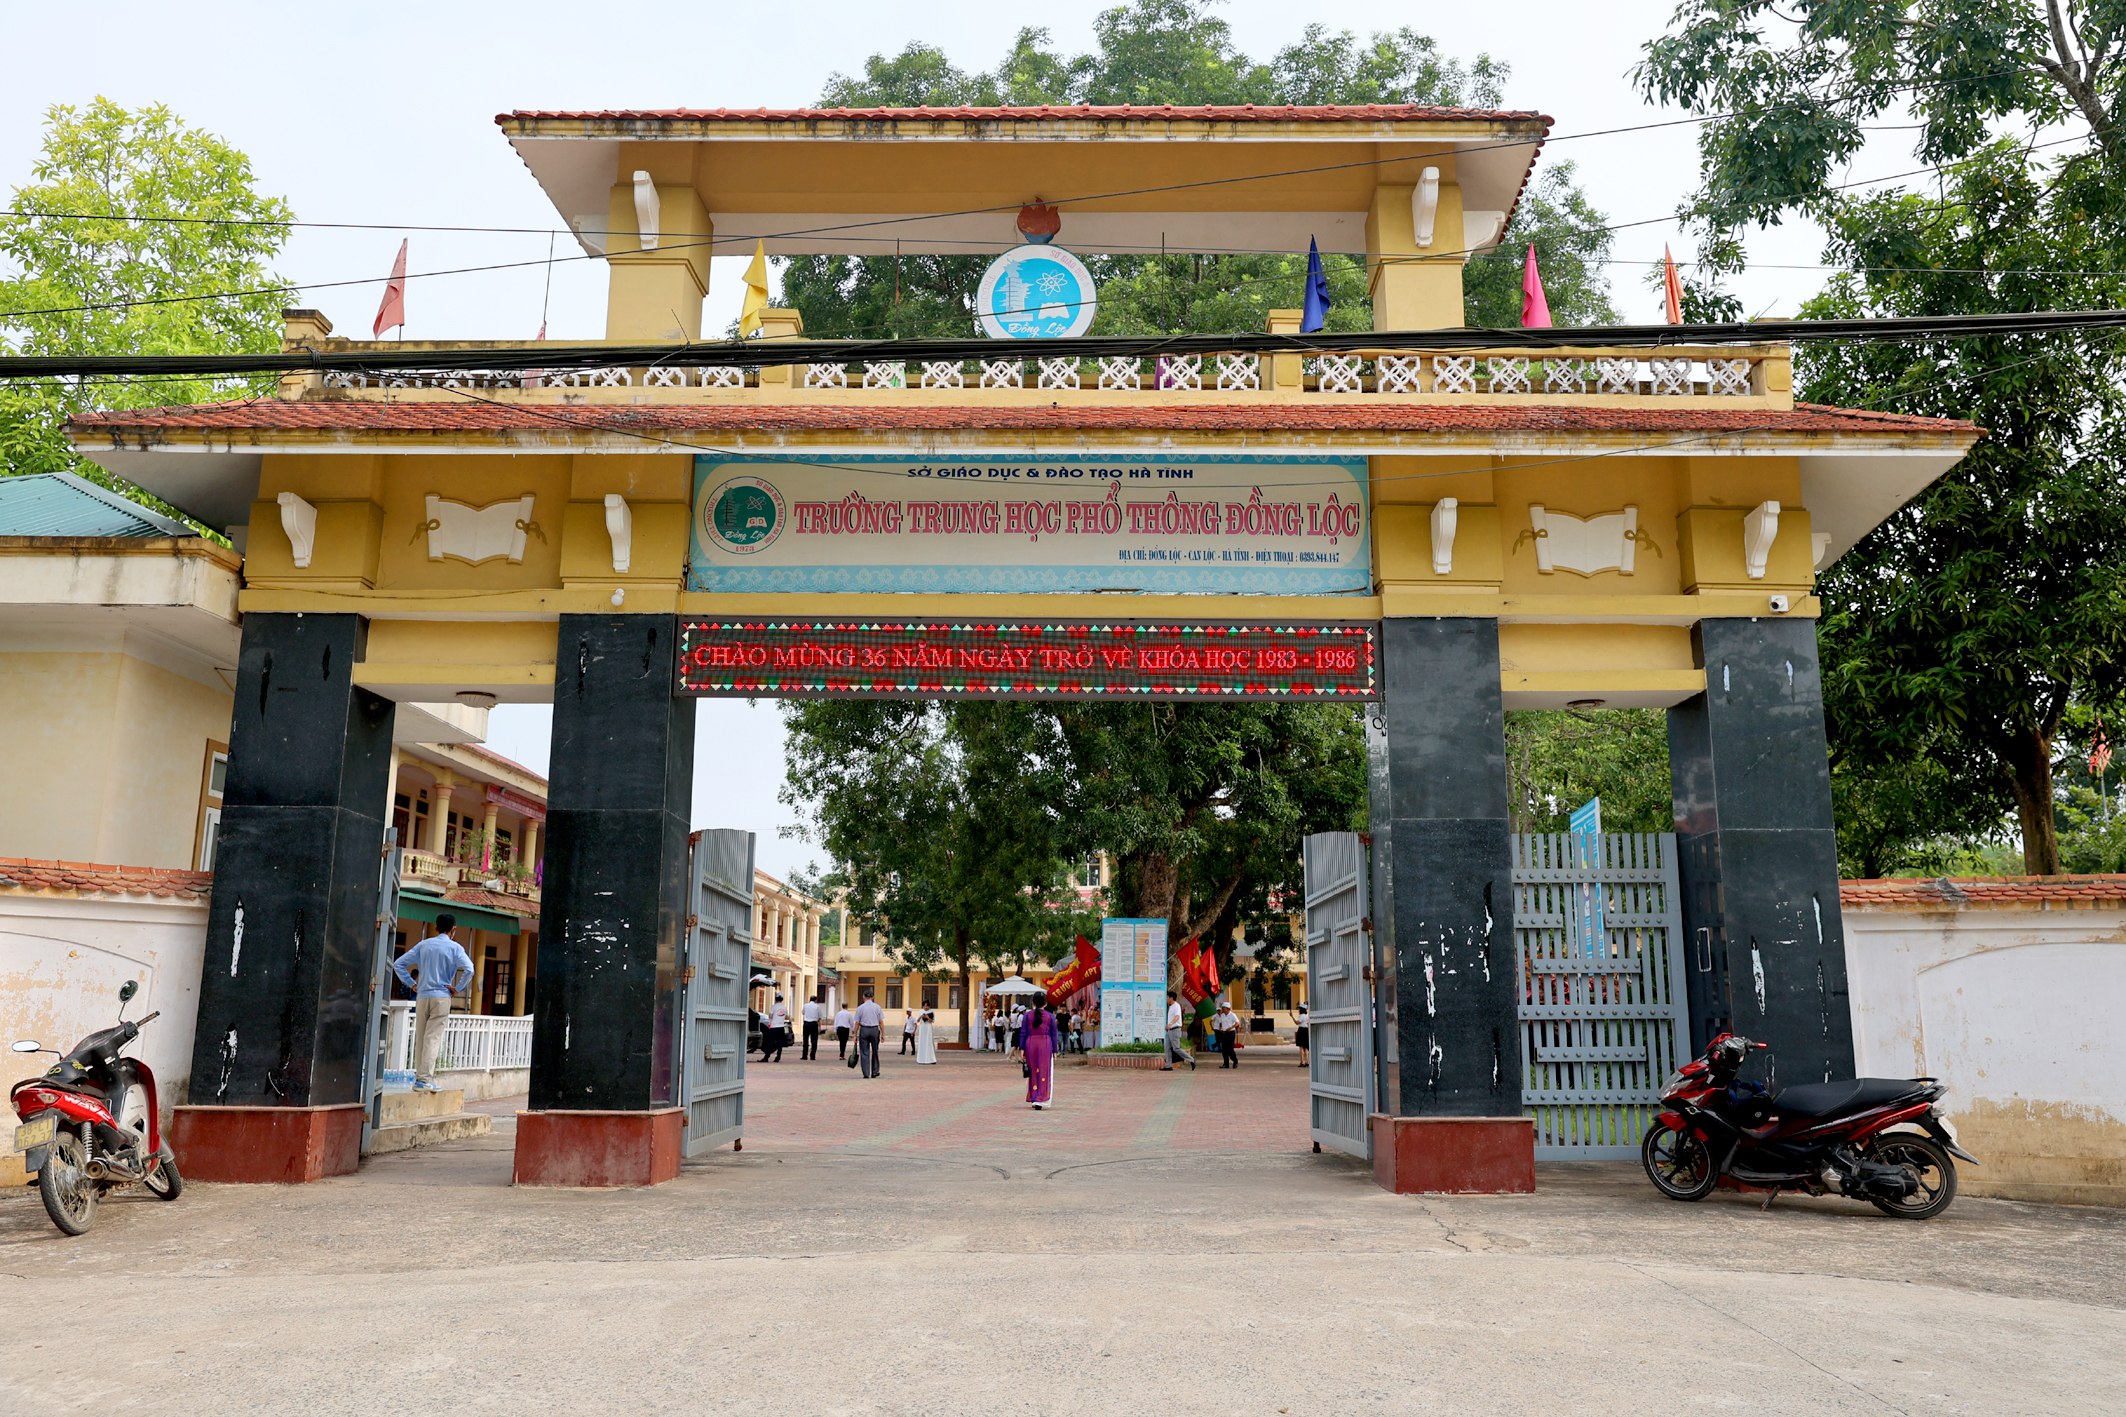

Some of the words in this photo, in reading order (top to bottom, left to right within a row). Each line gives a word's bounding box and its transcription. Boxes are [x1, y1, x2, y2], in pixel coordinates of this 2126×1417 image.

[907, 465, 932, 478] SỞ
[937, 466, 982, 478] GIÁO
[988, 468, 1021, 481] DỤC
[1026, 468, 1040, 478] &
[1046, 466, 1084, 478] ĐÀO
[1089, 468, 1123, 480] TẠO
[1129, 467, 1151, 479] HÀ
[1156, 467, 1193, 479] TĨNH
[794, 490, 903, 535] TRƯỜNG
[907, 500, 1000, 535] TRUNG
[1003, 500, 1061, 542] HỌC
[1065, 480, 1122, 535] PHỔ
[1126, 491, 1221, 535] THÔNG
[1225, 486, 1303, 536] ĐỒNG
[1307, 492, 1359, 544] LỘC
[1169, 546, 1182, 565] LỘC
[1188, 550, 1201, 561] CAN
[1203, 547, 1216, 565] LỘC
[1222, 548, 1232, 561] HÀ
[694, 641, 767, 666] CHÀO
[861, 648, 887, 667] 36
[893, 640, 953, 667] NĂM
[959, 643, 1033, 668] NGÀY
[1039, 644, 1094, 669] TRỞ
[1138, 645, 1200, 669] KHÓA
[1204, 650, 1251, 672] HỌC
[1256, 650, 1297, 669] 1983
[1315, 650, 1356, 669] 1986
